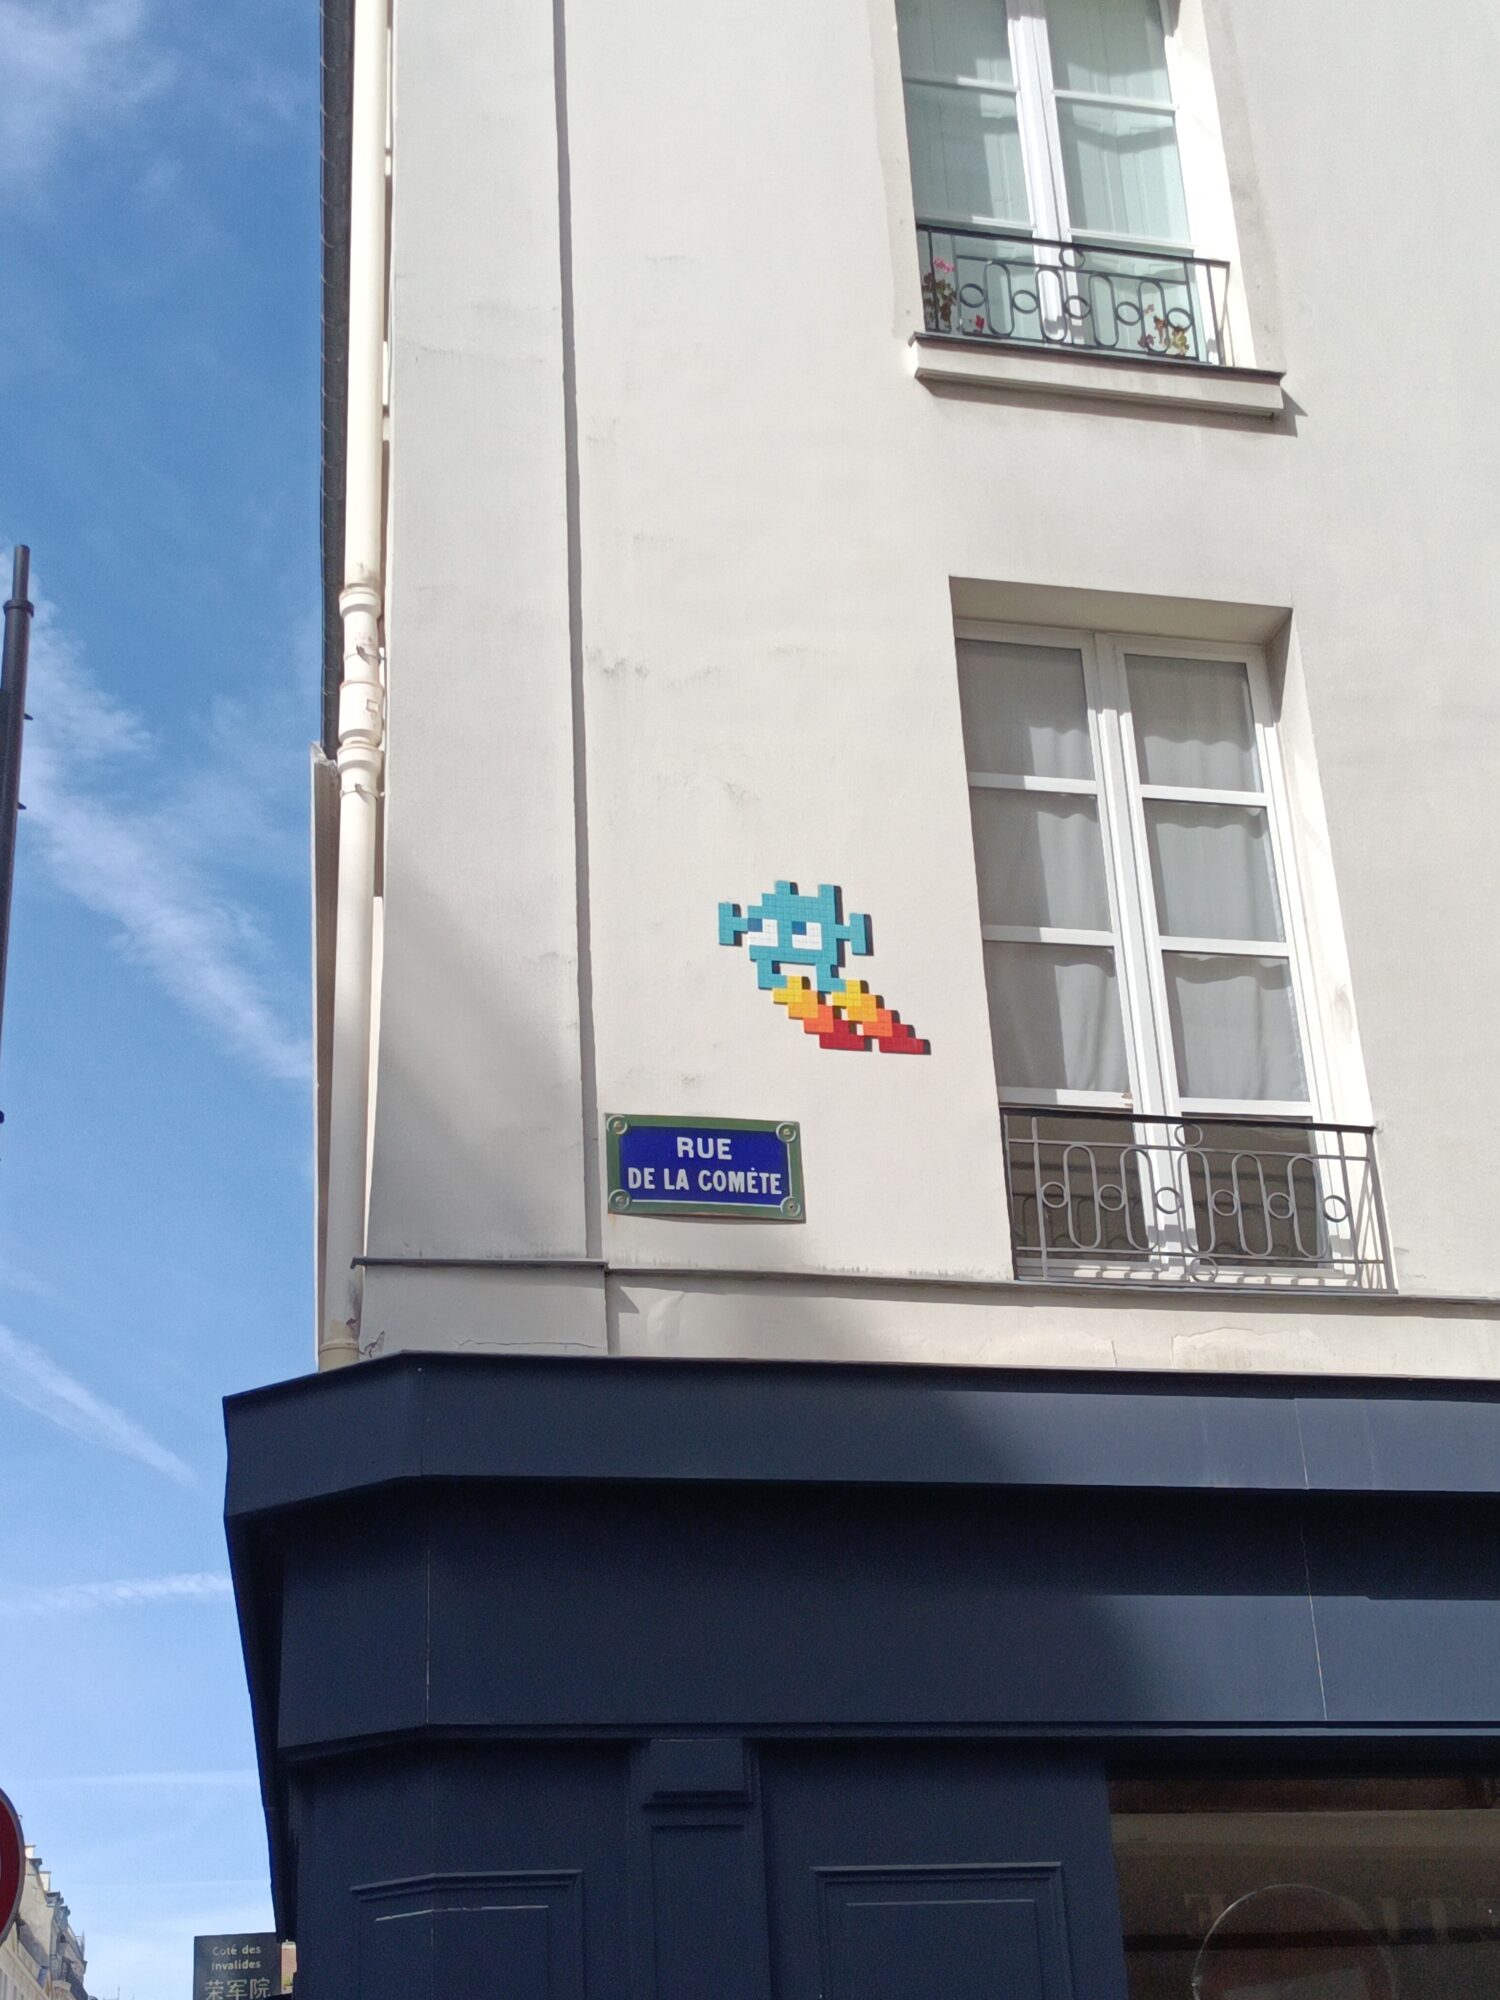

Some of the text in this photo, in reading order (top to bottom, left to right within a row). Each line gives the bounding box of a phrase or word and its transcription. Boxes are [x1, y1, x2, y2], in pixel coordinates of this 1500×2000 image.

[677, 1136, 732, 1160] RUE
[628, 1167, 782, 1195] DE LA COMÈTE
[242, 1945, 261, 1955] des
[204, 1977, 271, 2000] 荣军院
